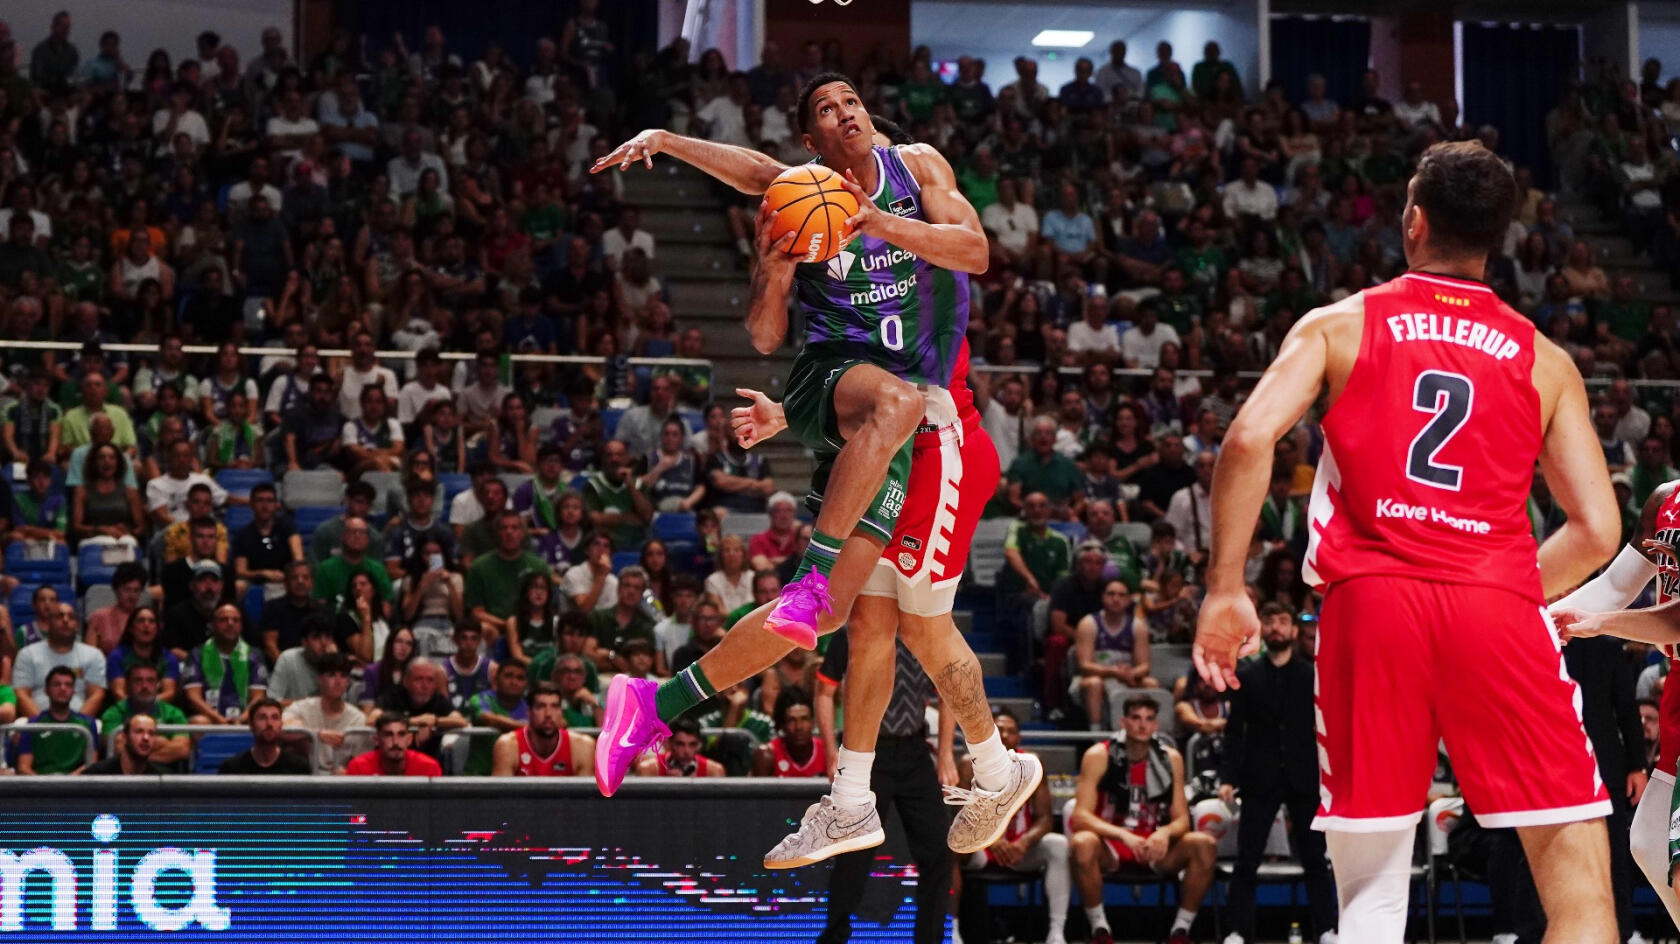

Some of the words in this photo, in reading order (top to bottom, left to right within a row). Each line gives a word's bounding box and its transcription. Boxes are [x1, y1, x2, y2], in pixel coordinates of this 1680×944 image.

[880, 314, 904, 351] 0
[1387, 313, 1520, 360] FJELLERUP
[1406, 369, 1474, 491] 2
[1376, 498, 1428, 521] Kave
[1431, 507, 1491, 534] Home
